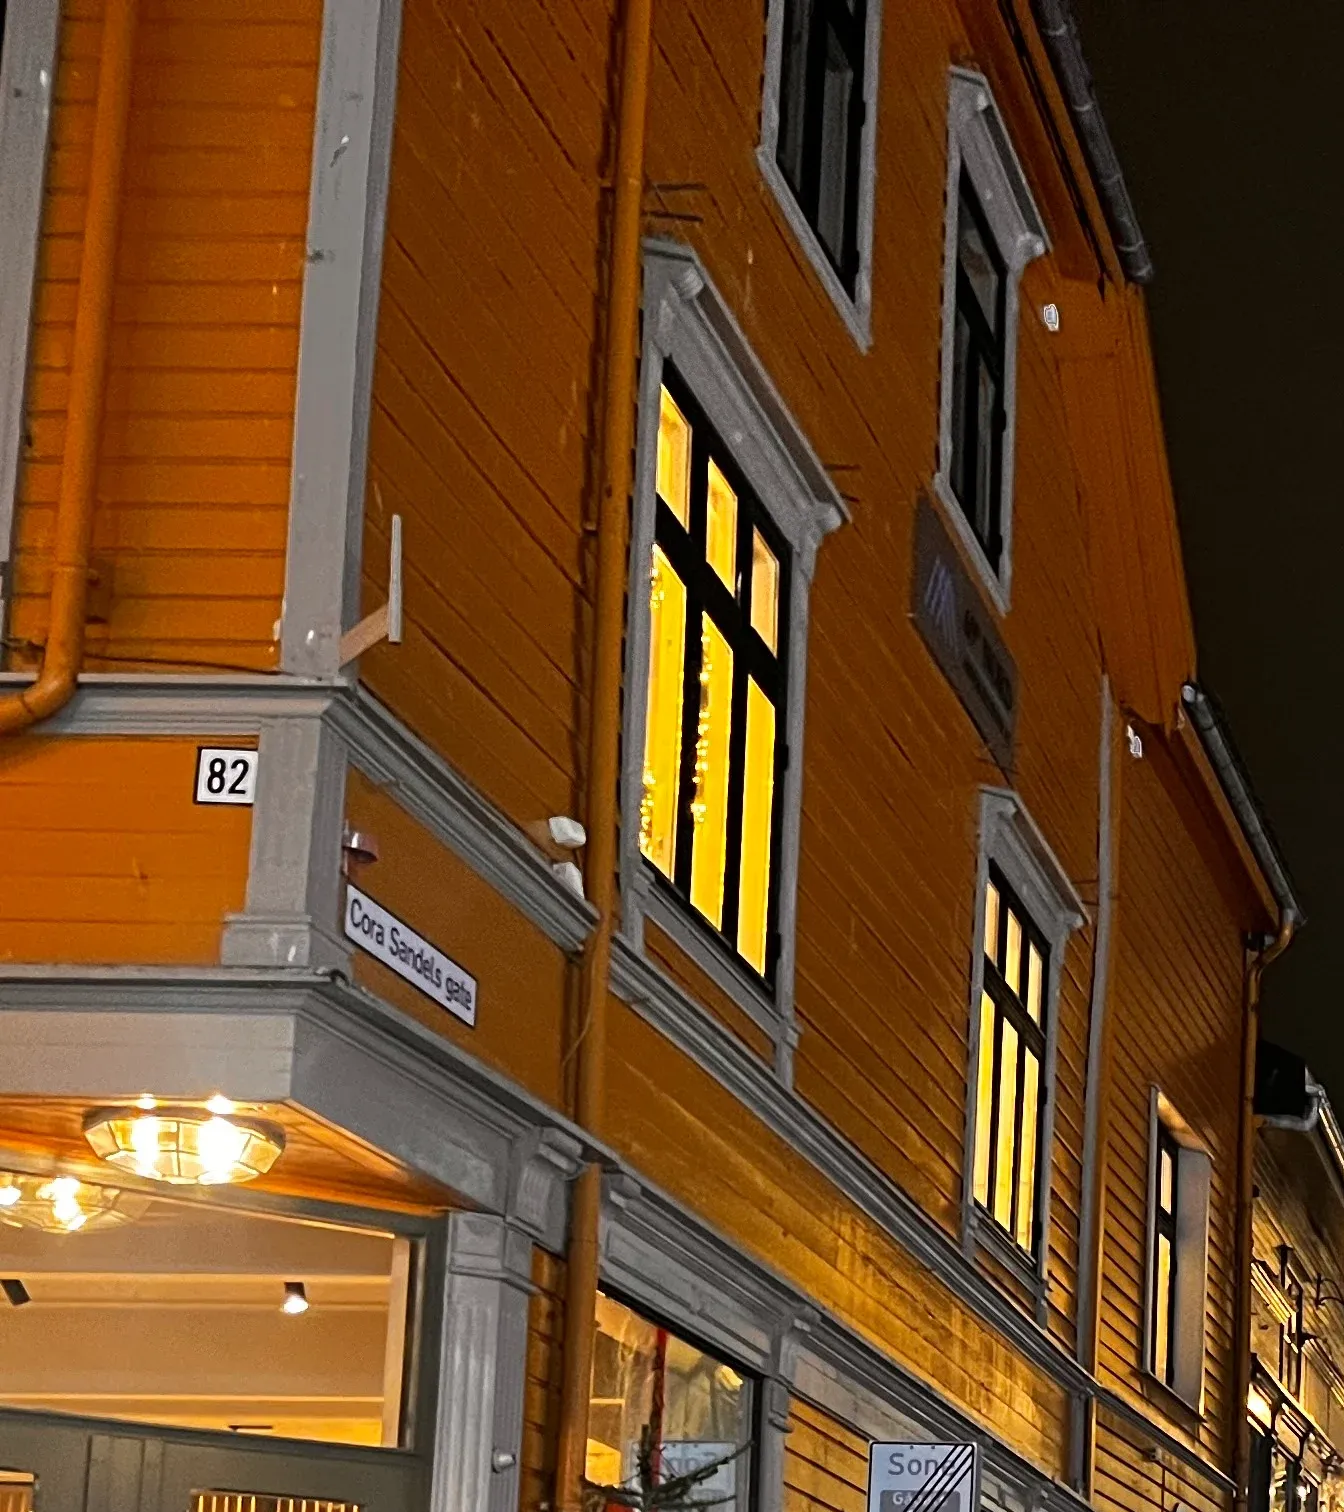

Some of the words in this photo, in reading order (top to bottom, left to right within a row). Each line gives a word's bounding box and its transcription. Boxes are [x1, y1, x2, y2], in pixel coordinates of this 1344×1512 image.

[206, 758, 249, 795] 82
[350, 898, 385, 947] Cora
[389, 926, 443, 989] Sandels
[445, 976, 472, 1011] gate
